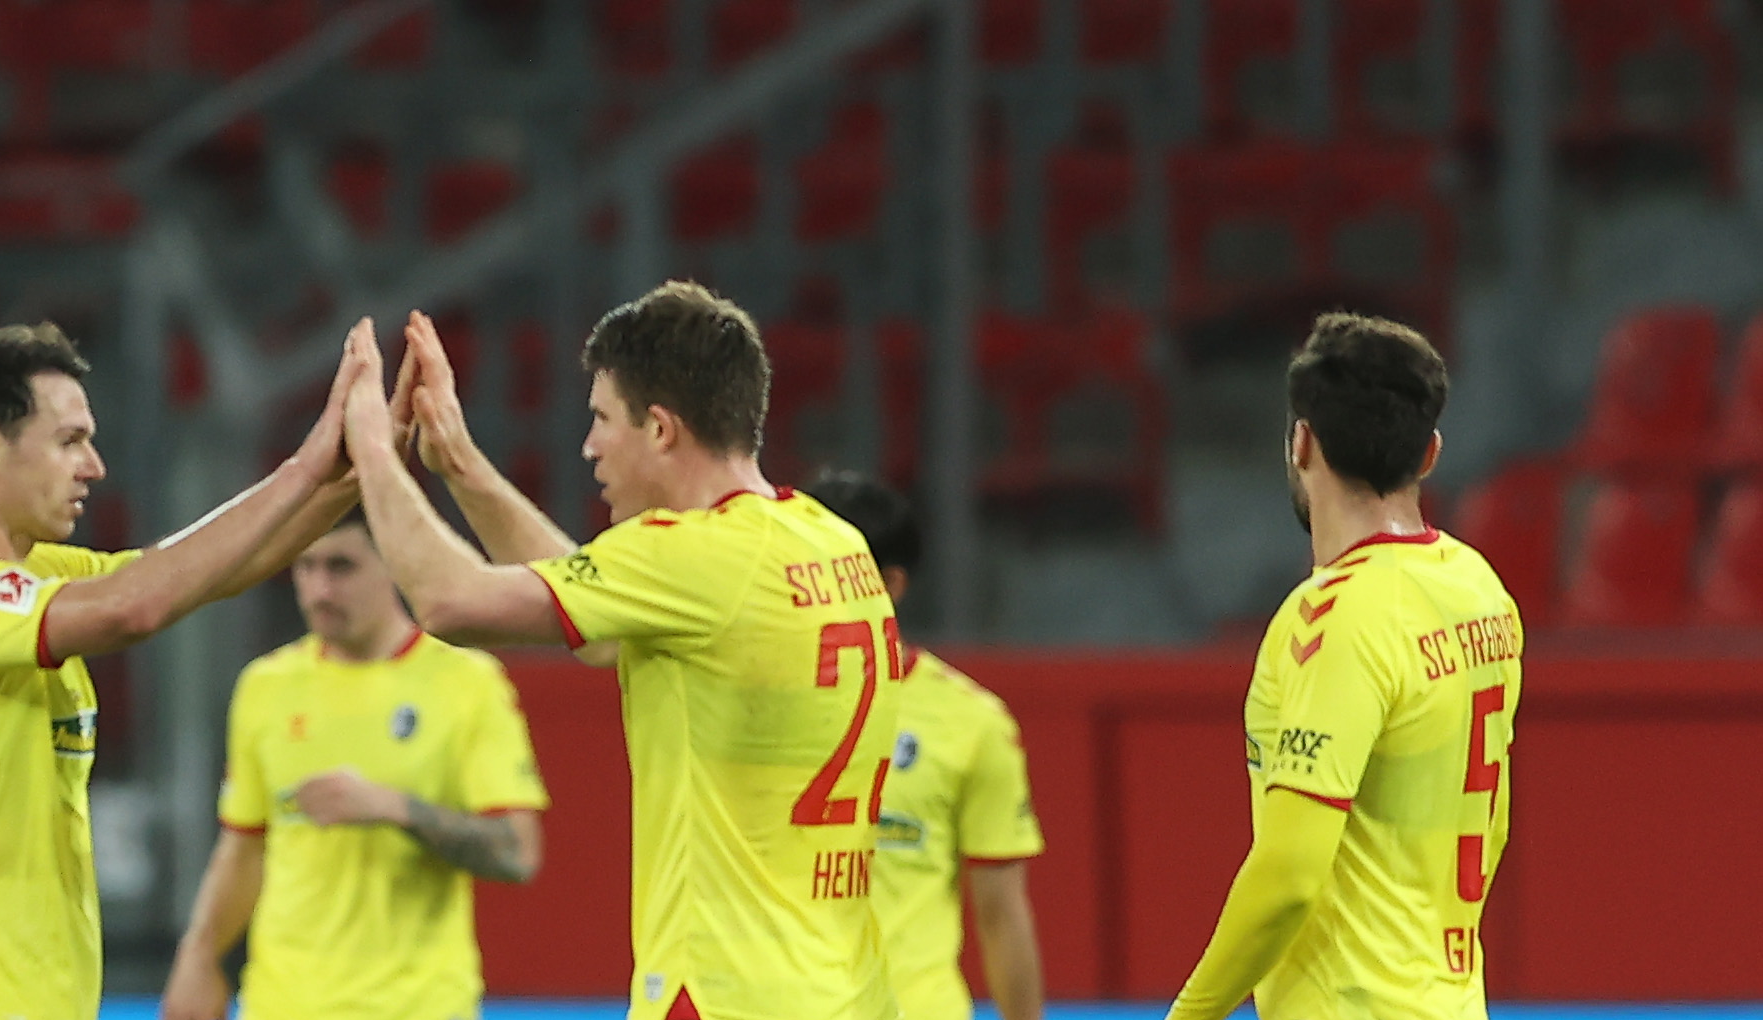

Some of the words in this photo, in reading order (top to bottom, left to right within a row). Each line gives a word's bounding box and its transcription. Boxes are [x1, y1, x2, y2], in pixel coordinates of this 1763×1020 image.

[785, 562, 832, 608] SC
[1418, 629, 1457, 681] SC
[1457, 684, 1509, 903] 5
